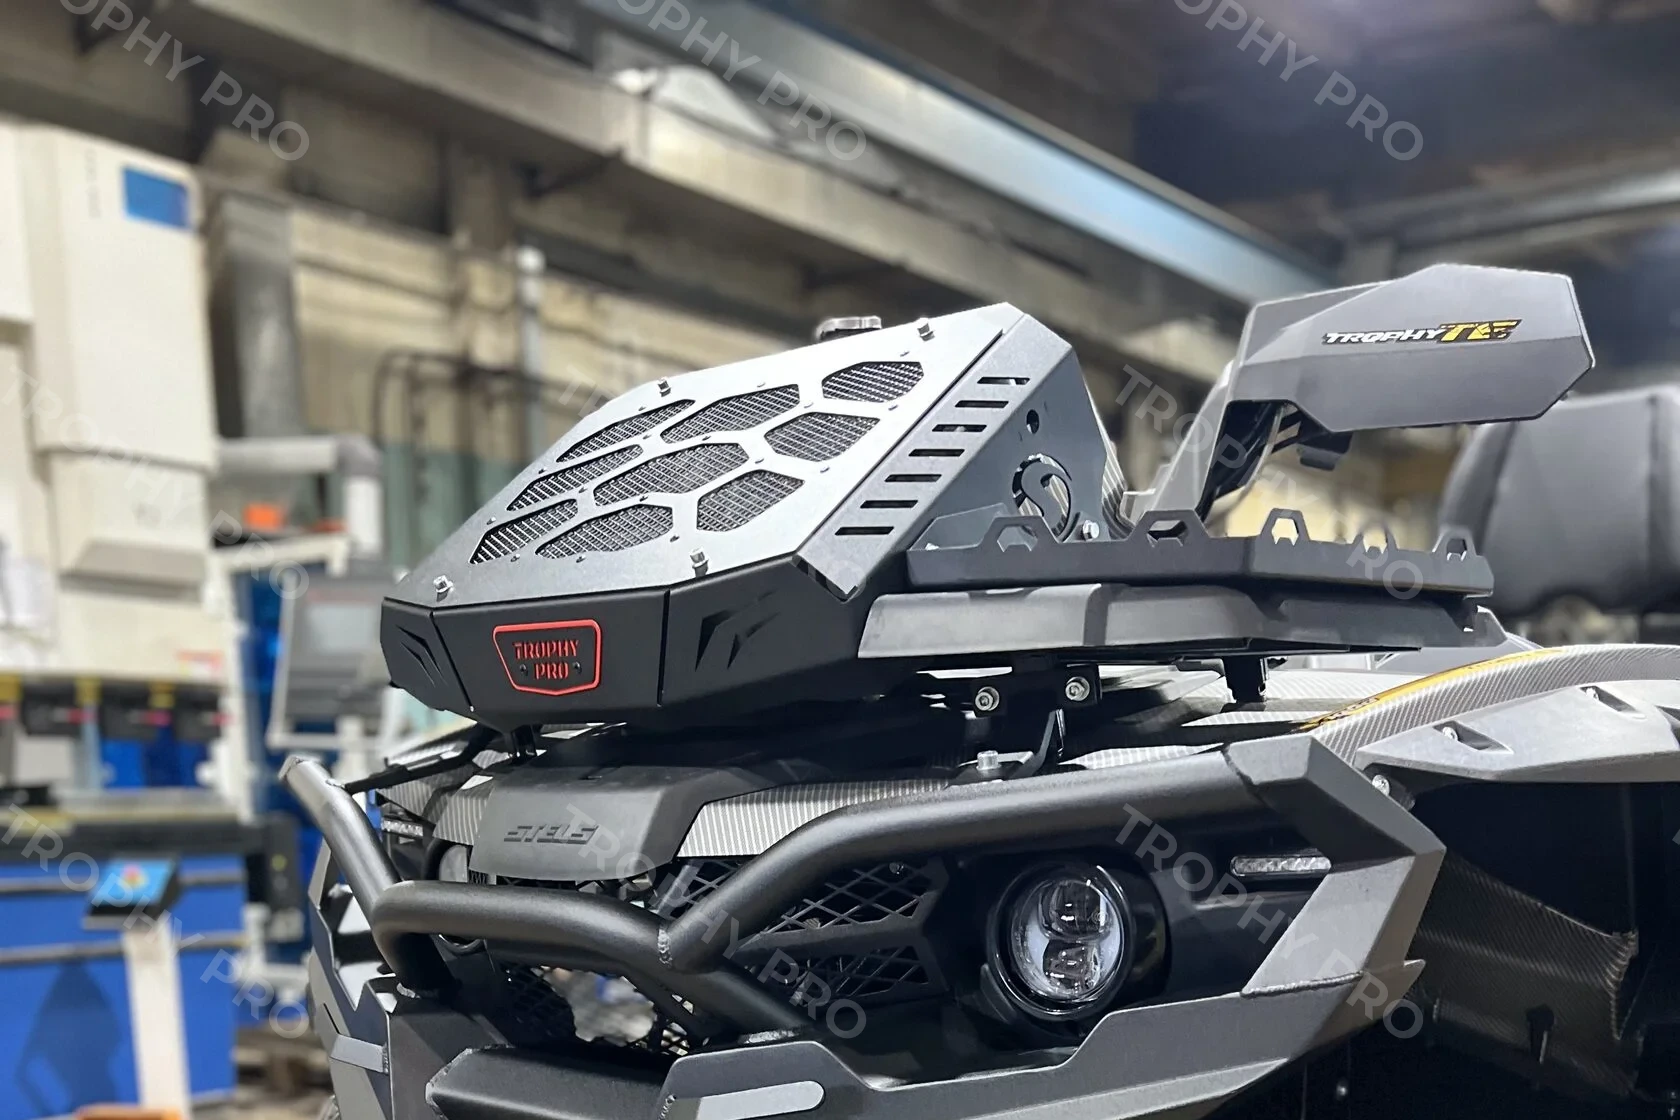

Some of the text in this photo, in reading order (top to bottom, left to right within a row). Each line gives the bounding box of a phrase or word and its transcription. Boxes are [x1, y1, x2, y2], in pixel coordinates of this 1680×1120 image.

[513, 640, 579, 660] TROPHY
[535, 662, 569, 680] PRO
[503, 825, 600, 845] STELS
